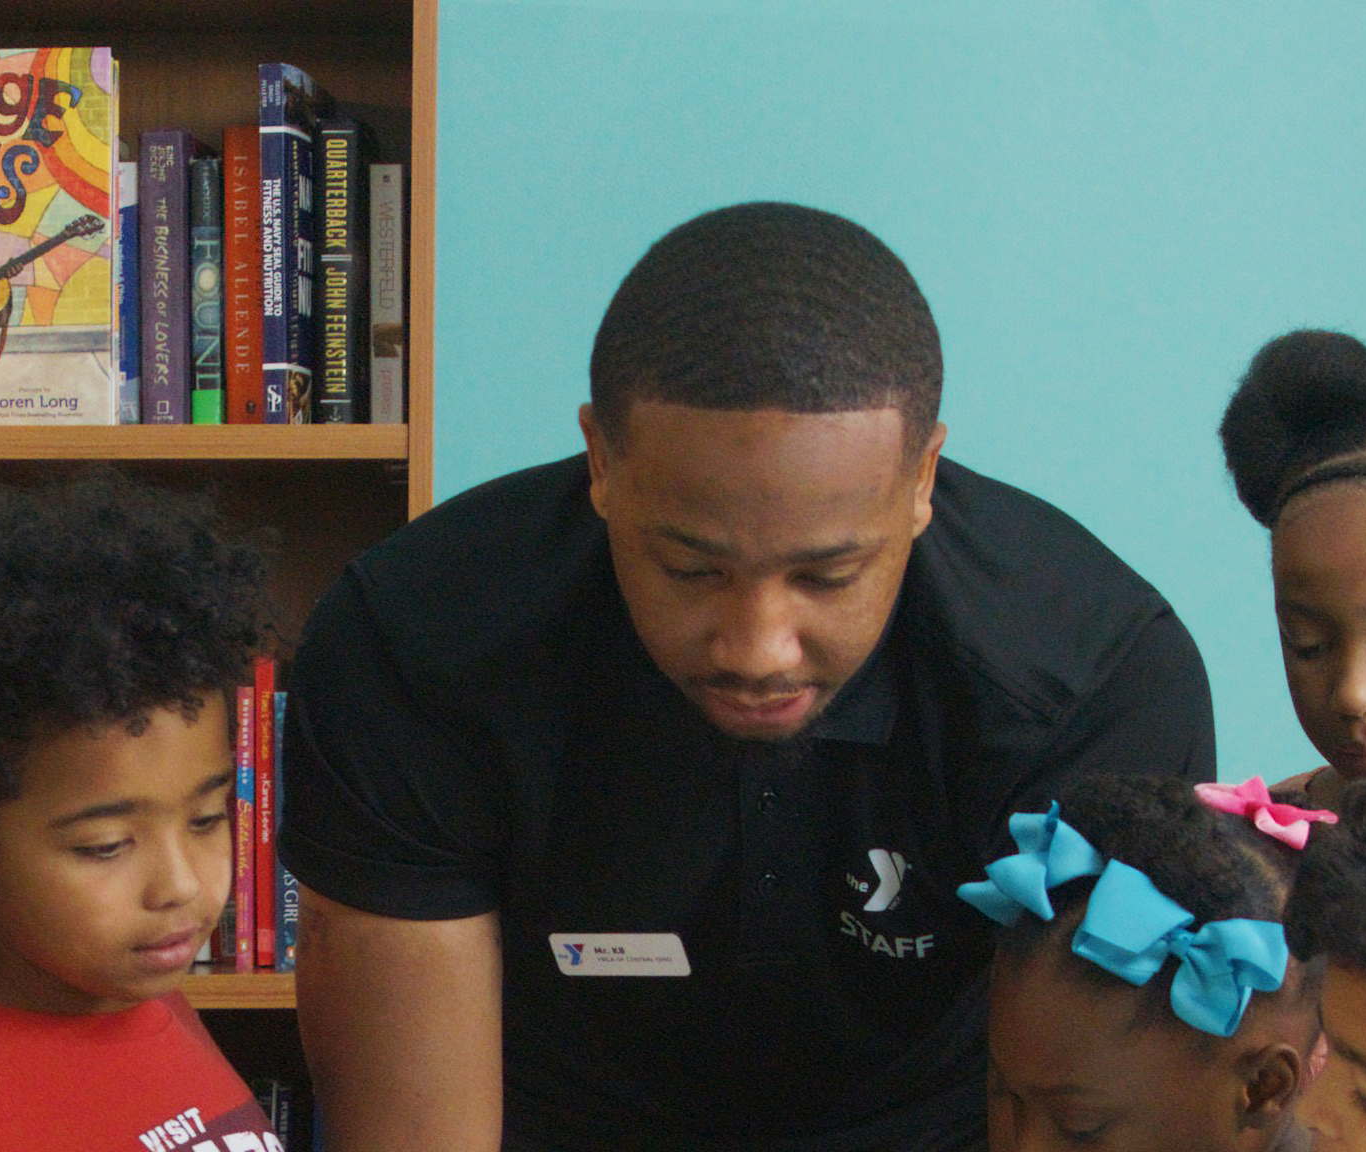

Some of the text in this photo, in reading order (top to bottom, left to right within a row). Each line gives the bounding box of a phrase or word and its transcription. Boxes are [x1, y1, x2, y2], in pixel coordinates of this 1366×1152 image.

[155, 197, 168, 221] THE
[324, 138, 348, 249] QUARTERBACK
[153, 225, 171, 298] BUSINESS
[233, 155, 250, 375] ISABEL ALLENDE
[262, 179, 273, 317] FITNESS AND NUTRITION
[272, 178, 282, 317] THE U.S. NAVY SEAL GUIDE TO
[378, 199, 394, 310] WESTERFELD
[154, 321, 170, 386] LOVERS
[324, 267, 348, 394] JOHN FEINSTEIN
[40, 394, 79, 411] Long
[284, 889, 299, 925] GIRL
[840, 911, 934, 958] STAFF
